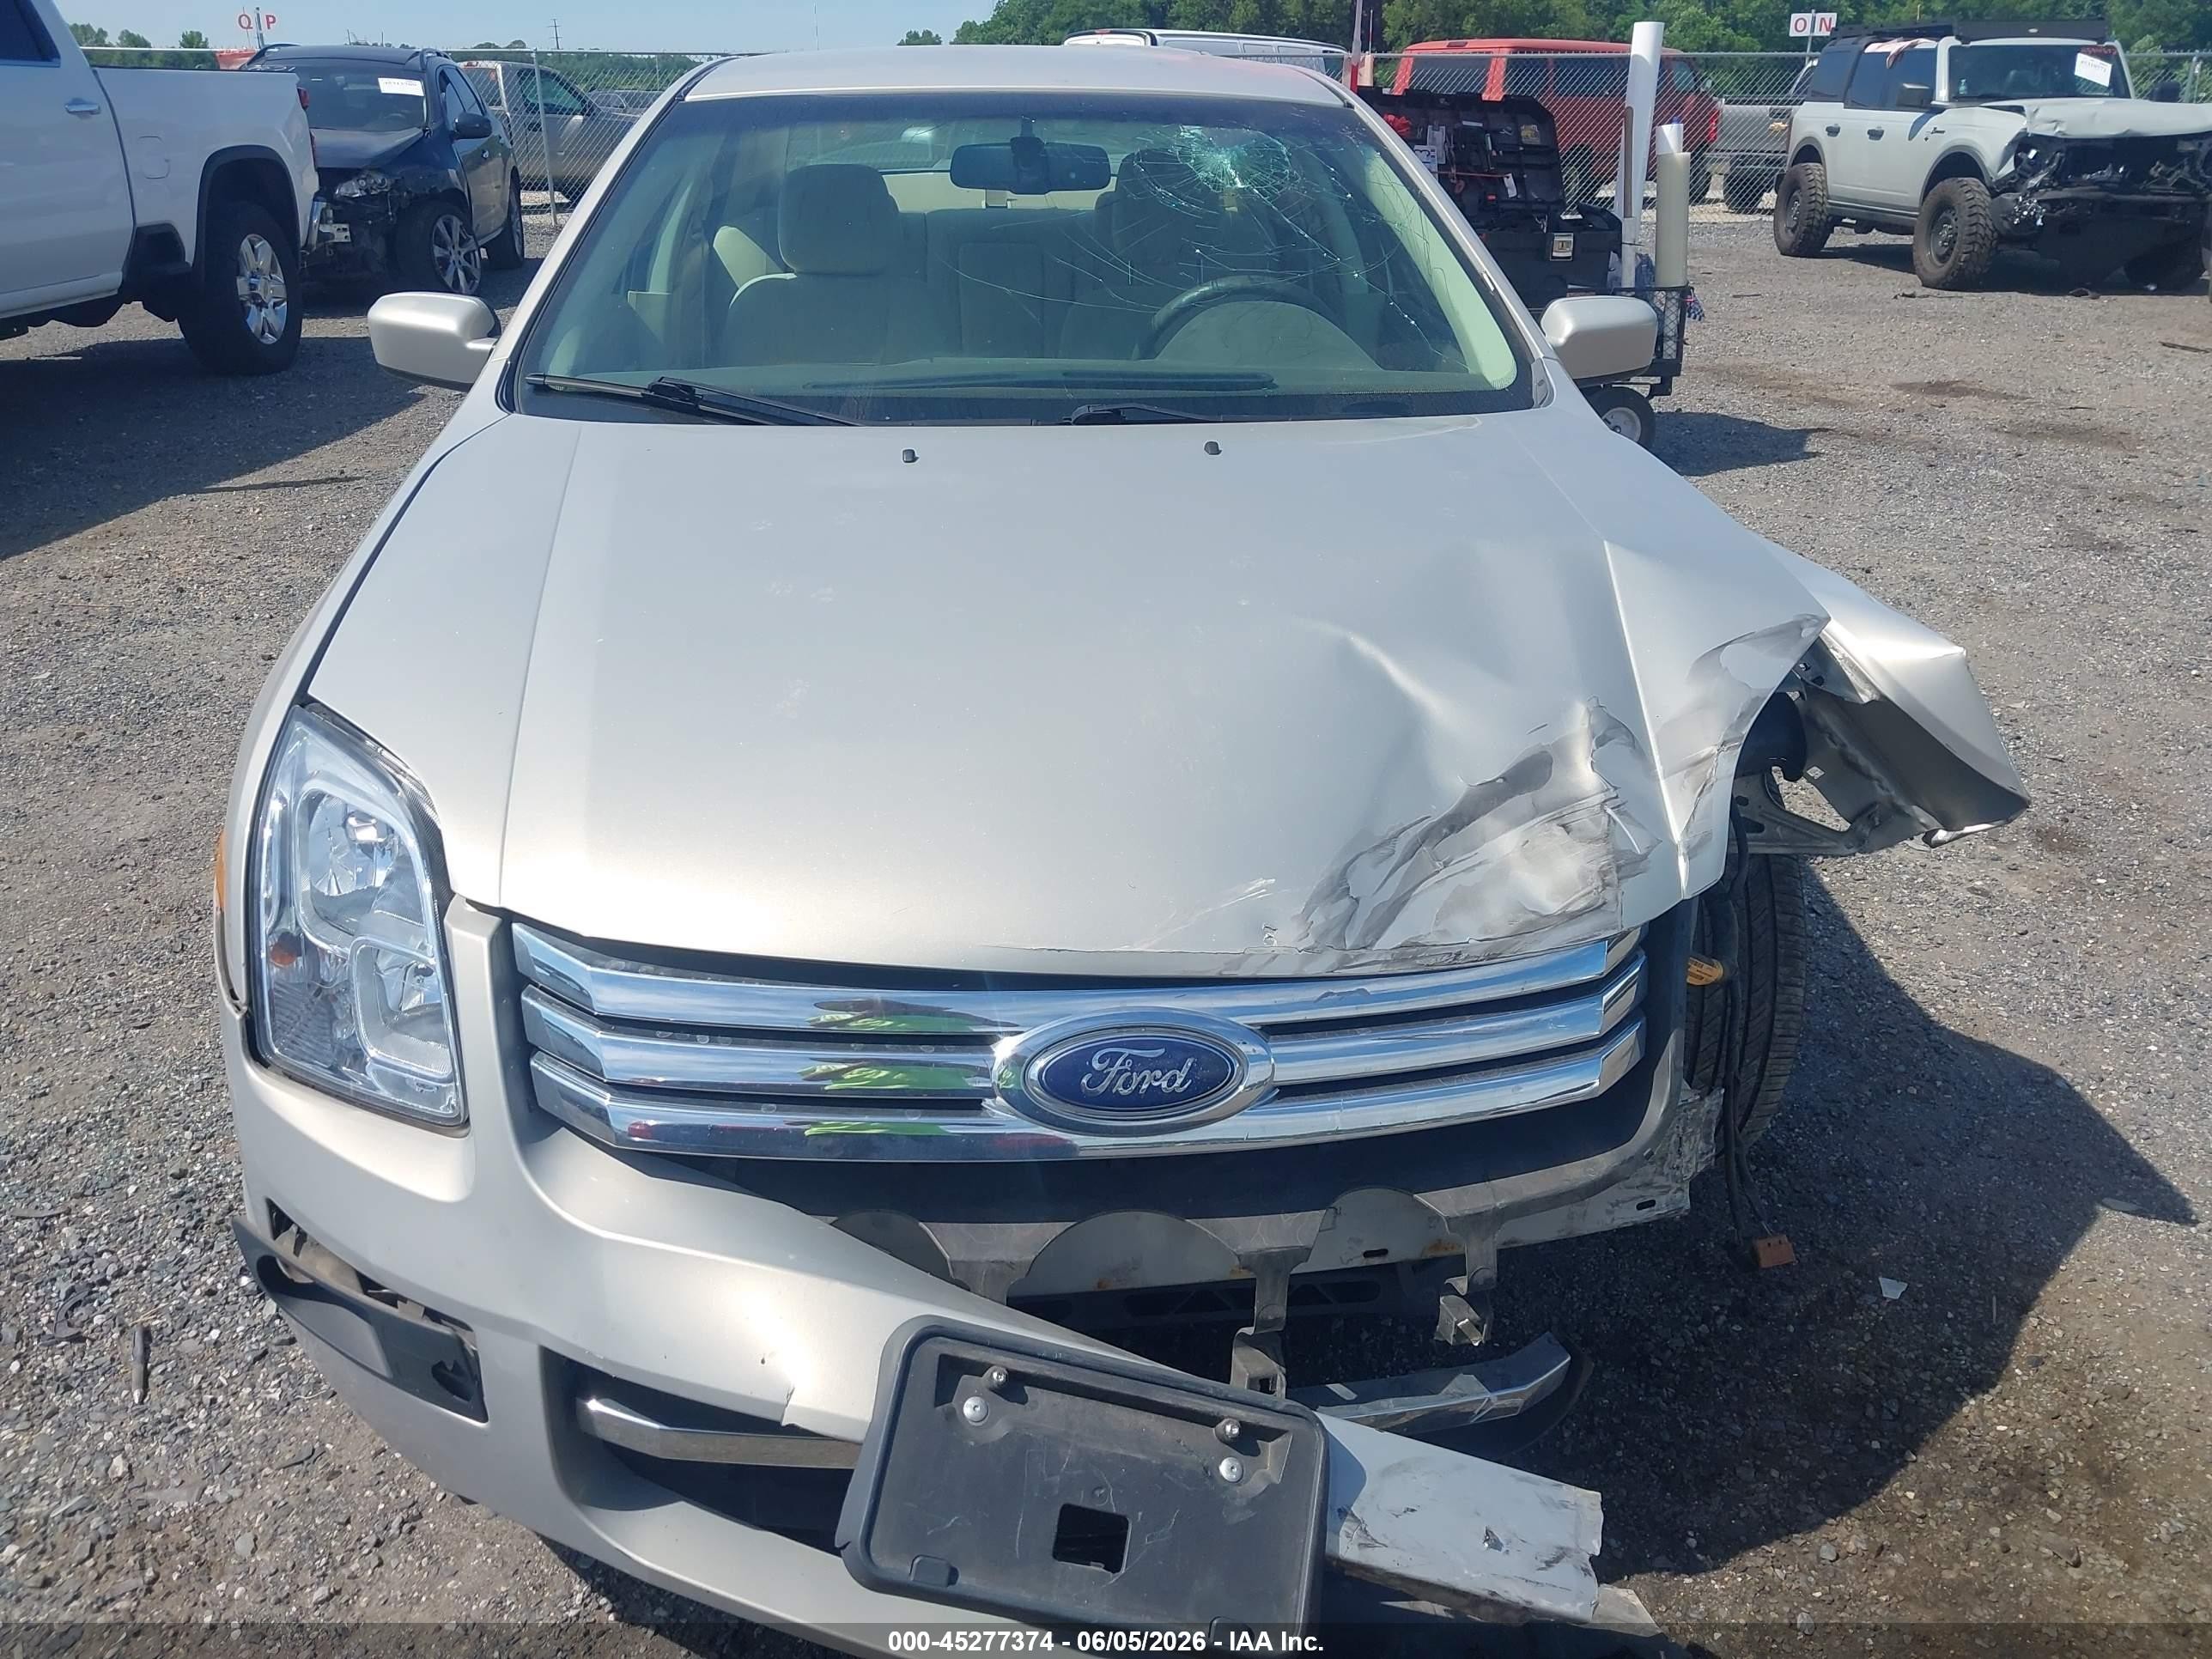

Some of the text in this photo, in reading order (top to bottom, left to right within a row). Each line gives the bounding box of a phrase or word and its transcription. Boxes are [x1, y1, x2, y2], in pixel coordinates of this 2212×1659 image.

[238, 14, 276, 30] Q P
[1794, 17, 1832, 33] O N
[1080, 1047, 1194, 1097] Ford
